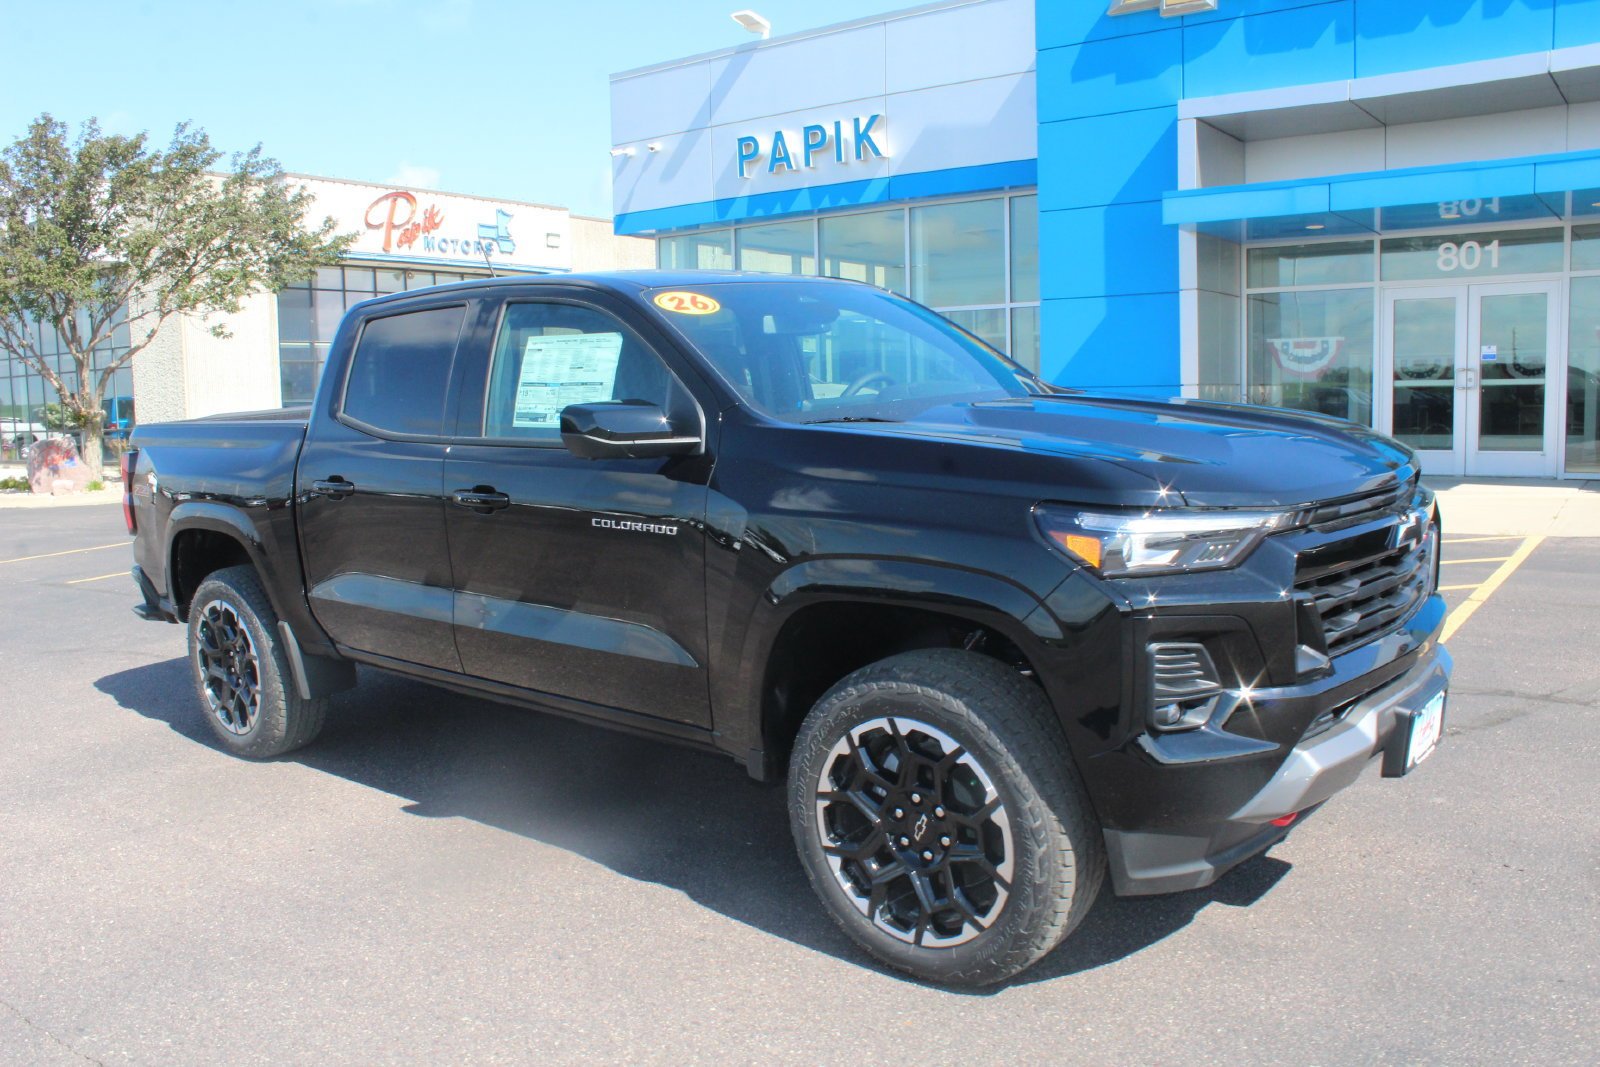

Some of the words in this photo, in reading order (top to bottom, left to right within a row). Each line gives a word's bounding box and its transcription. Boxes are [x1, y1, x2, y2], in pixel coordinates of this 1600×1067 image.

[736, 114, 885, 178] PAPIK
[364, 191, 444, 253] Papik
[423, 235, 494, 256] MOTORS
[1437, 240, 1500, 271] 801
[667, 295, 709, 311] 26
[591, 518, 678, 535] COLORADO
